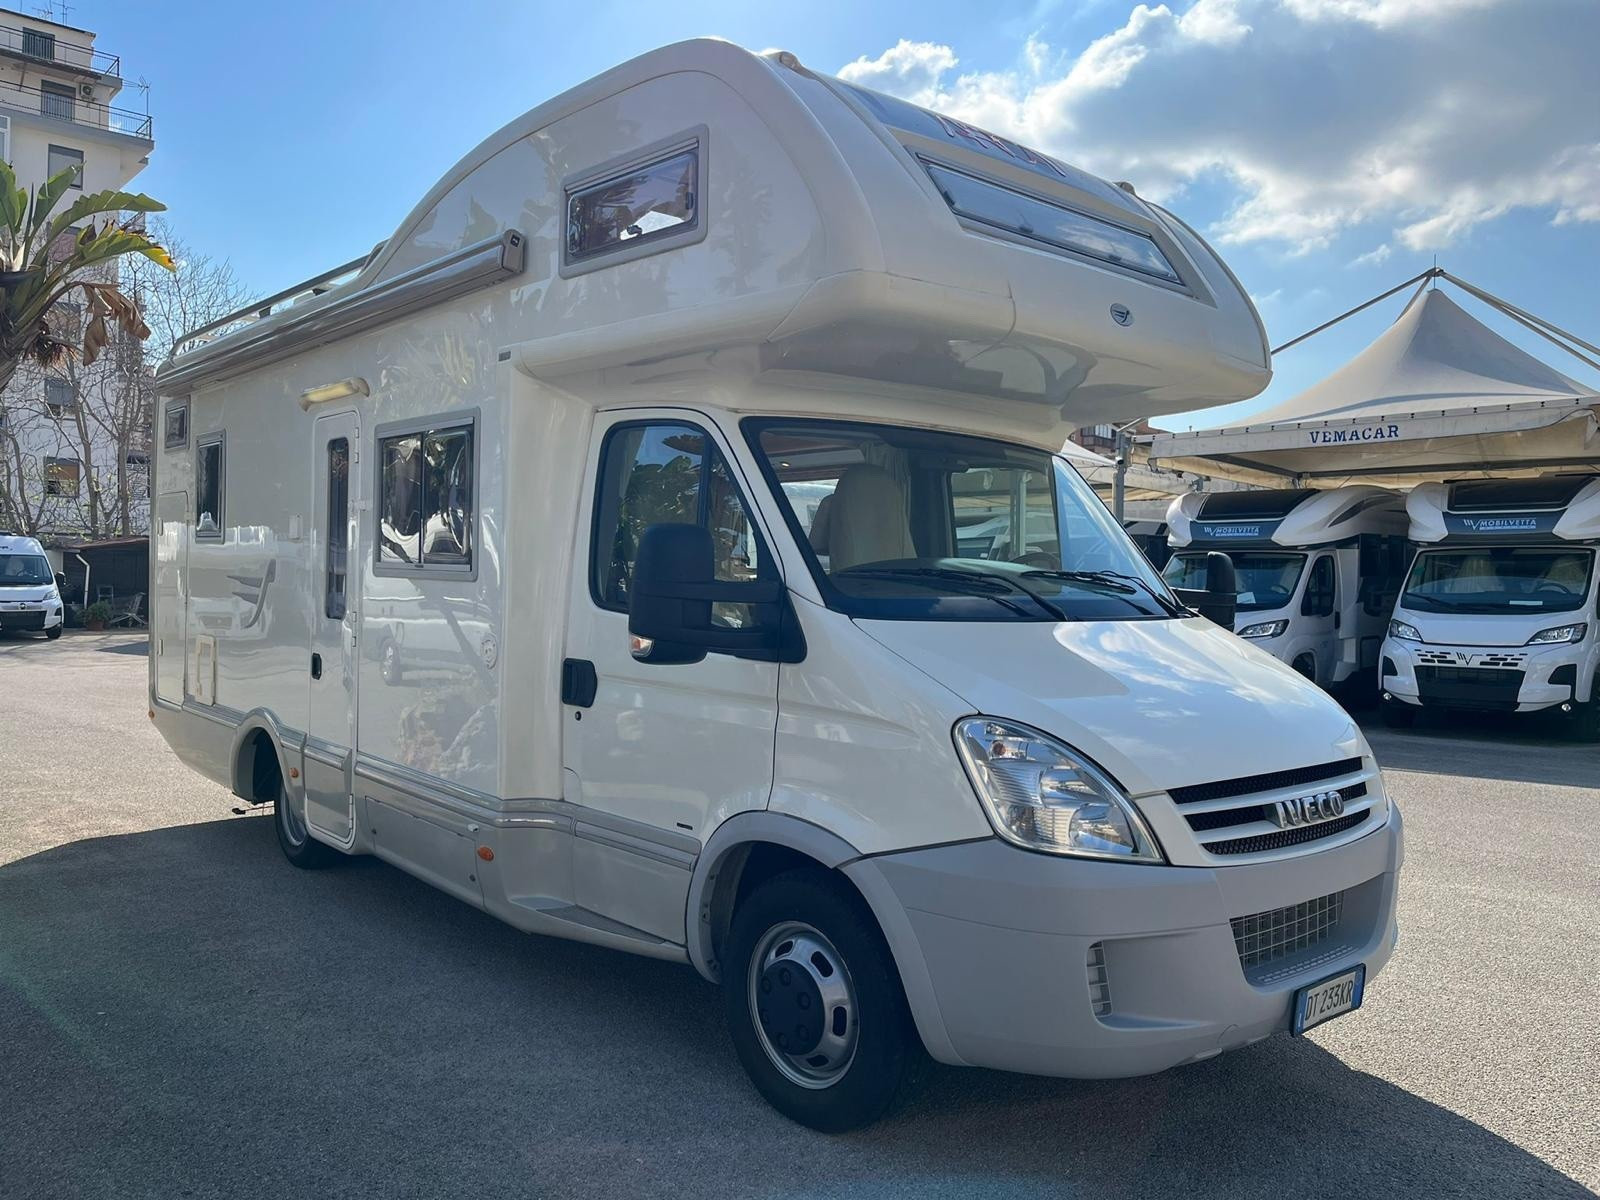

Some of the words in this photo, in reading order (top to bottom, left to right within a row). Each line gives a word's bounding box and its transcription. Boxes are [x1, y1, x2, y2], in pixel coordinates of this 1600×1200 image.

[1309, 425, 1399, 443] VEMACAR
[1480, 519, 1536, 527] MOBILVETTA
[1275, 791, 1345, 828] IVECO
[1305, 992, 1320, 1021] DT
